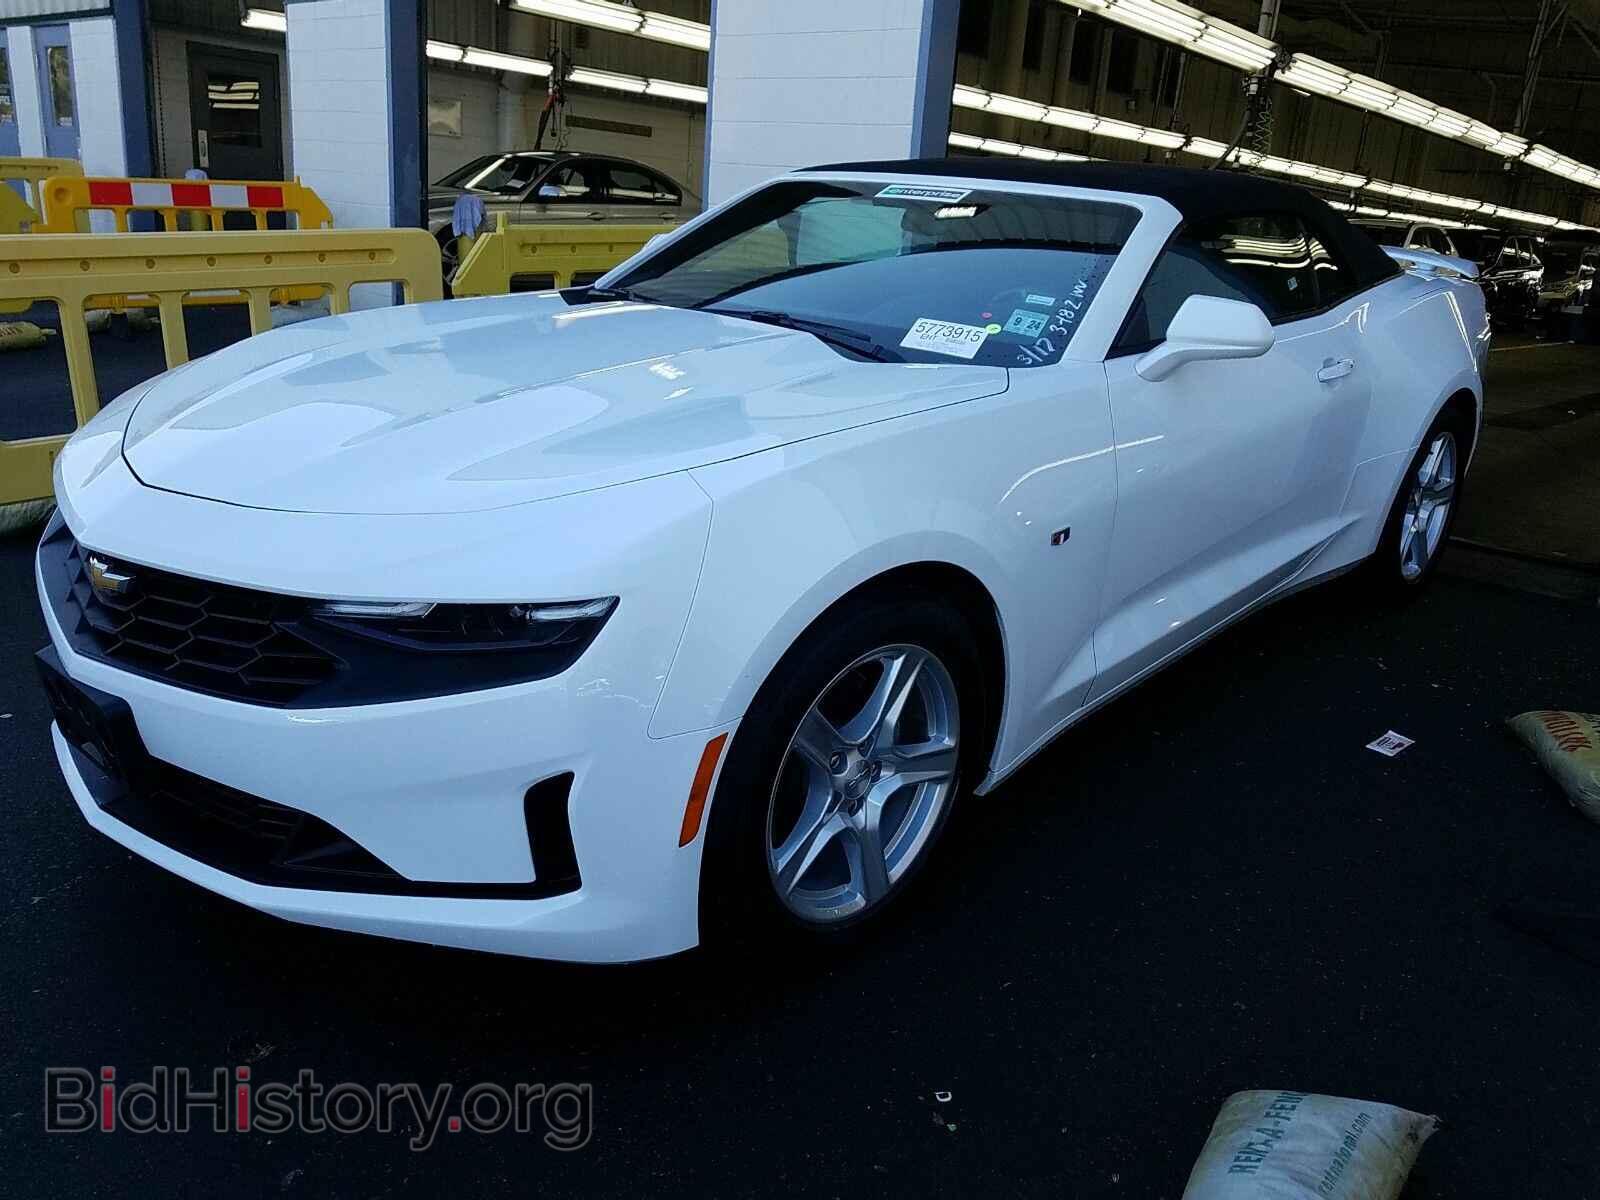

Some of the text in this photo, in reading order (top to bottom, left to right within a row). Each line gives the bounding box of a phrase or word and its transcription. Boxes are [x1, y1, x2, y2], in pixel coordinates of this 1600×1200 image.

[887, 187, 961, 199] enterprise
[915, 321, 983, 343] 5773915
[1013, 316, 1042, 331] 9 24
[1228, 1091, 1308, 1175] RENT-A-FEN
